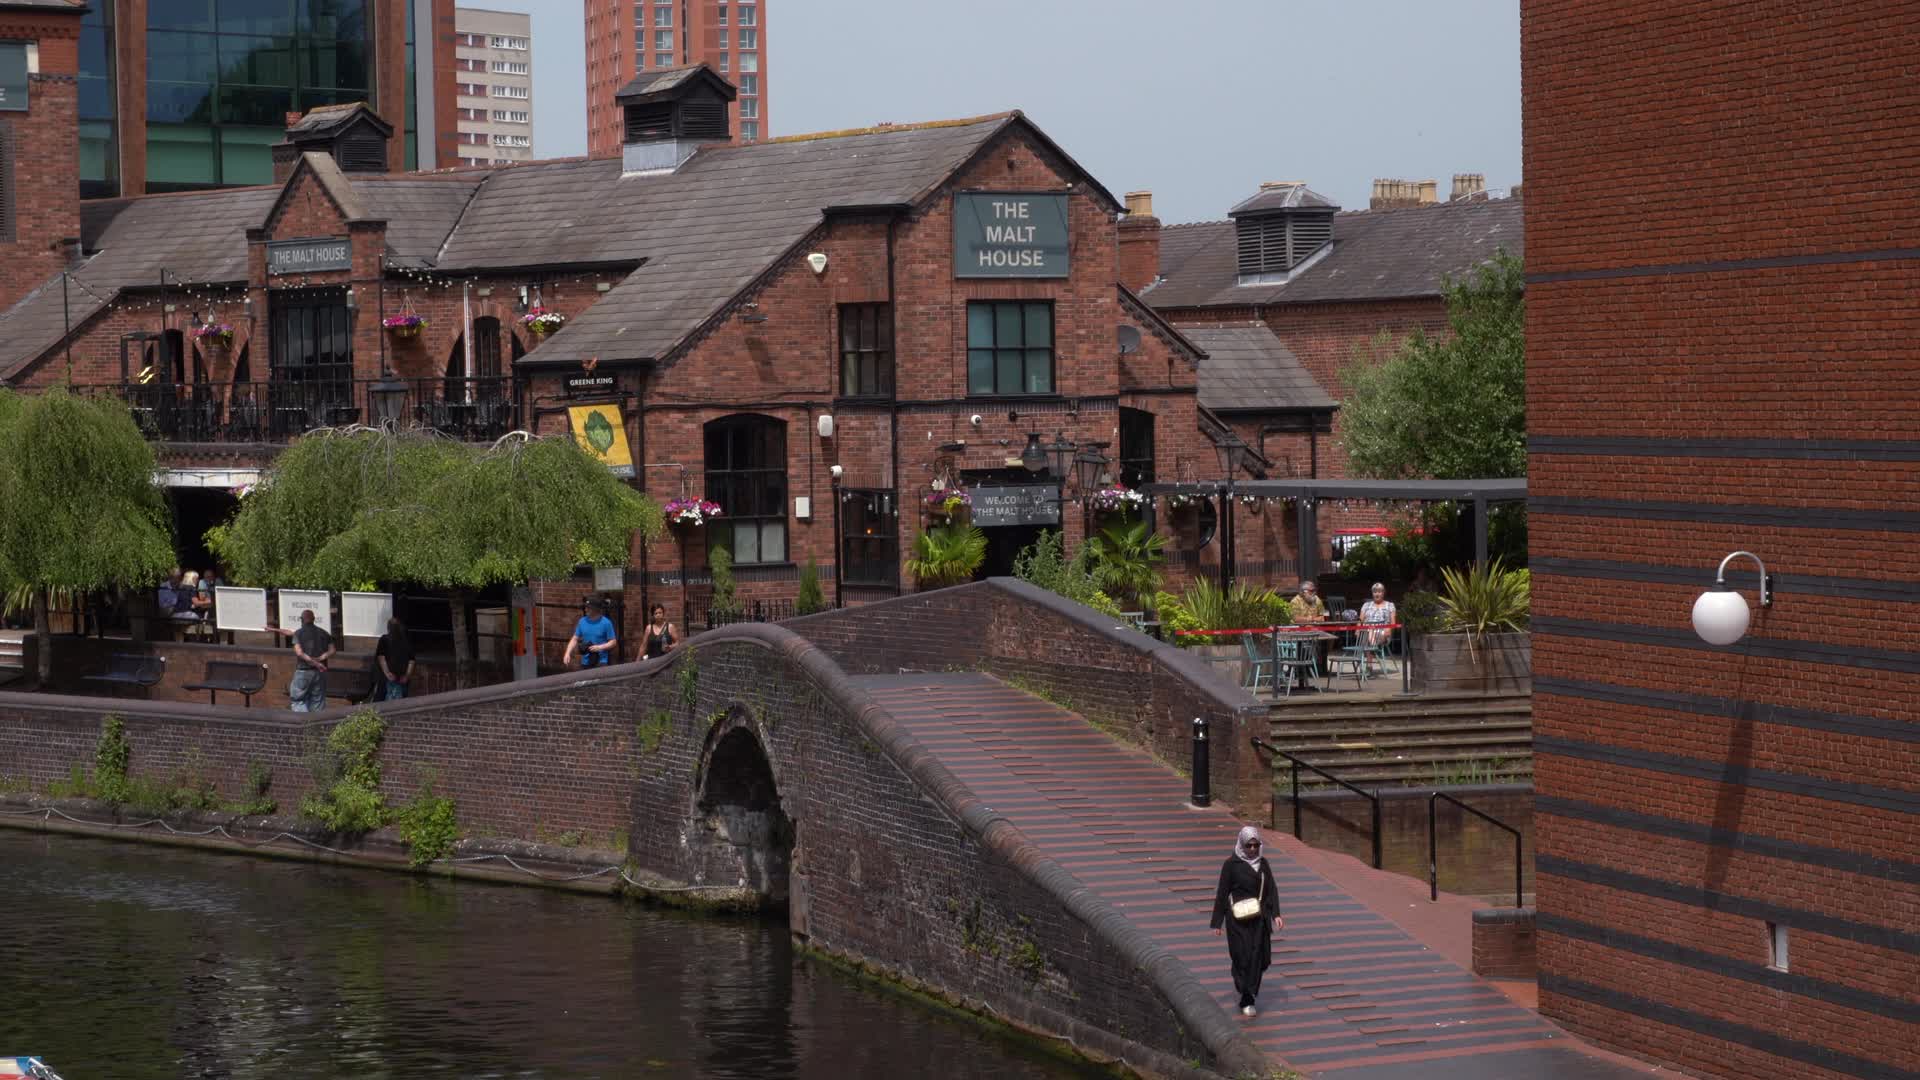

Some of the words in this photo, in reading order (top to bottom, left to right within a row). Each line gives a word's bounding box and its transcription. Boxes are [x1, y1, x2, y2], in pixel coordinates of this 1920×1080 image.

[992, 202, 1030, 218] THE
[986, 226, 1036, 242] MALT
[274, 251, 291, 264] THE
[292, 249, 315, 263] MALT
[316, 247, 346, 261] HOUSE
[979, 250, 1044, 266] HOUSE
[985, 495, 1030, 505] WELCOME
[1032, 494, 1044, 504] TO
[977, 508, 995, 516] THE
[996, 507, 1019, 516] MALT
[1022, 505, 1053, 514] HOUSE
